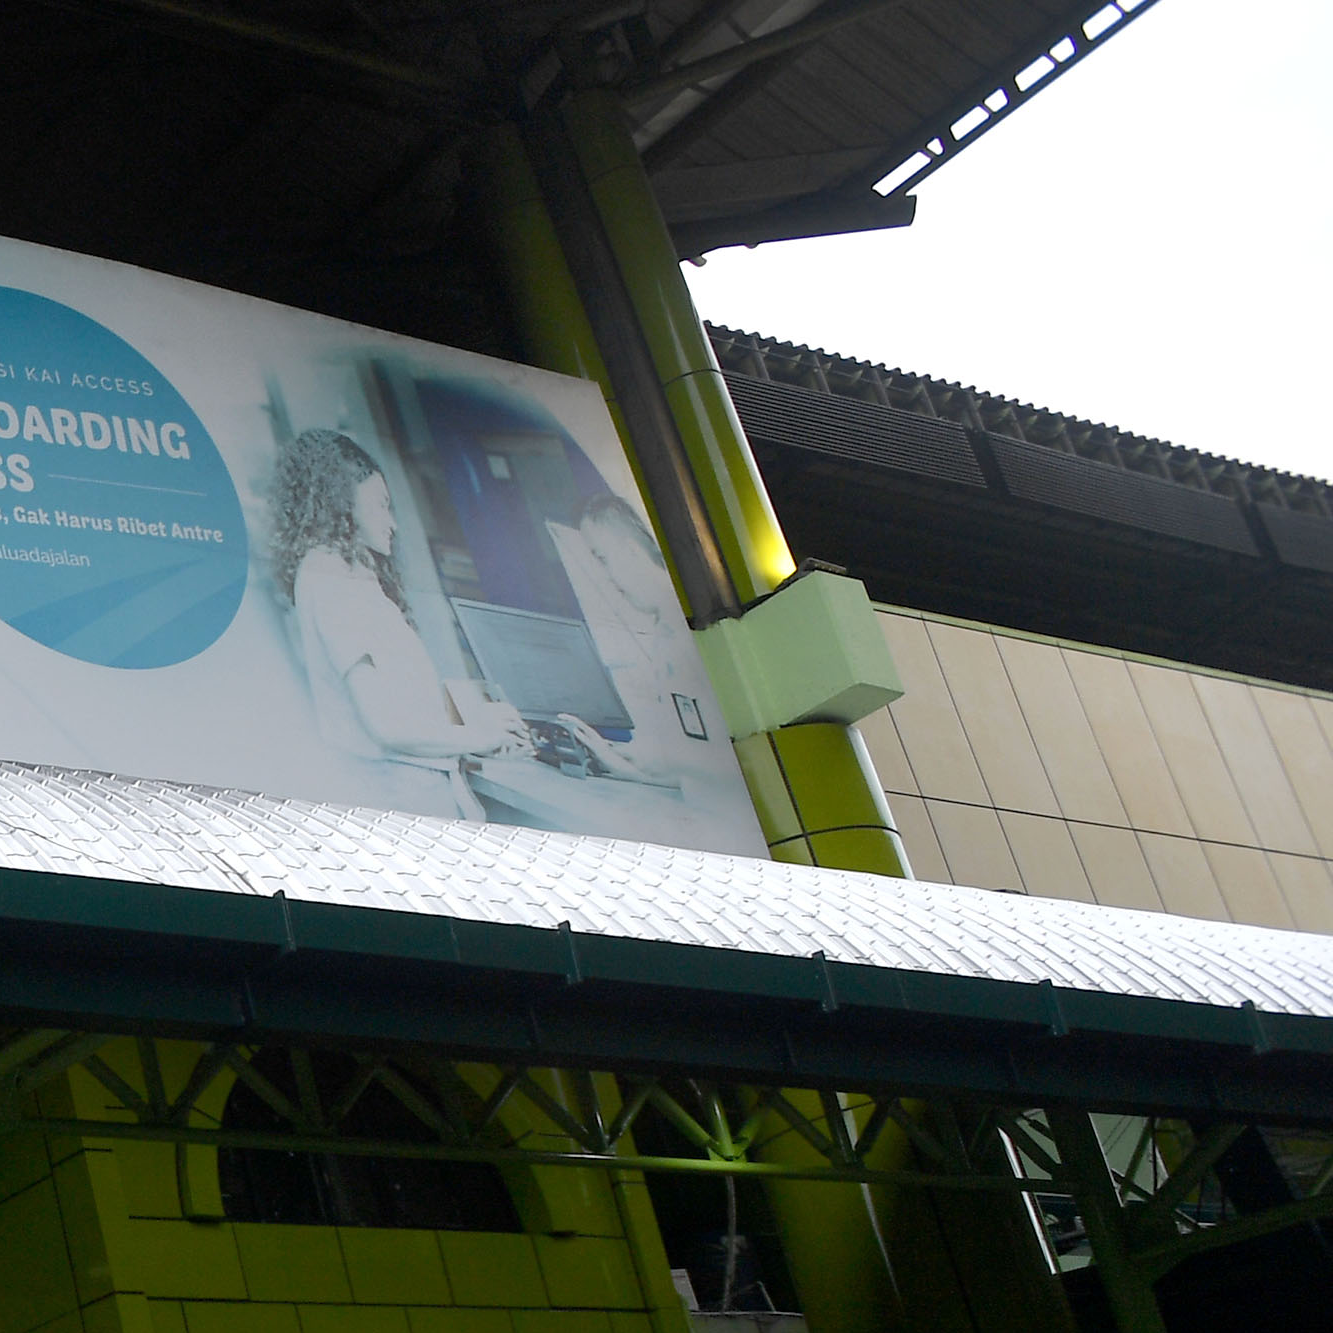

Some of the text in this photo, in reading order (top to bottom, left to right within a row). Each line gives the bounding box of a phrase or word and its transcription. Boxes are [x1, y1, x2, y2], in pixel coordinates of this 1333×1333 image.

[26, 367, 61, 385] KAI
[71, 373, 153, 396] ACCESS
[14, 506, 50, 526] Gak
[54, 511, 112, 531] Harus
[118, 516, 167, 538] Ribet
[171, 522, 224, 543] Antre
